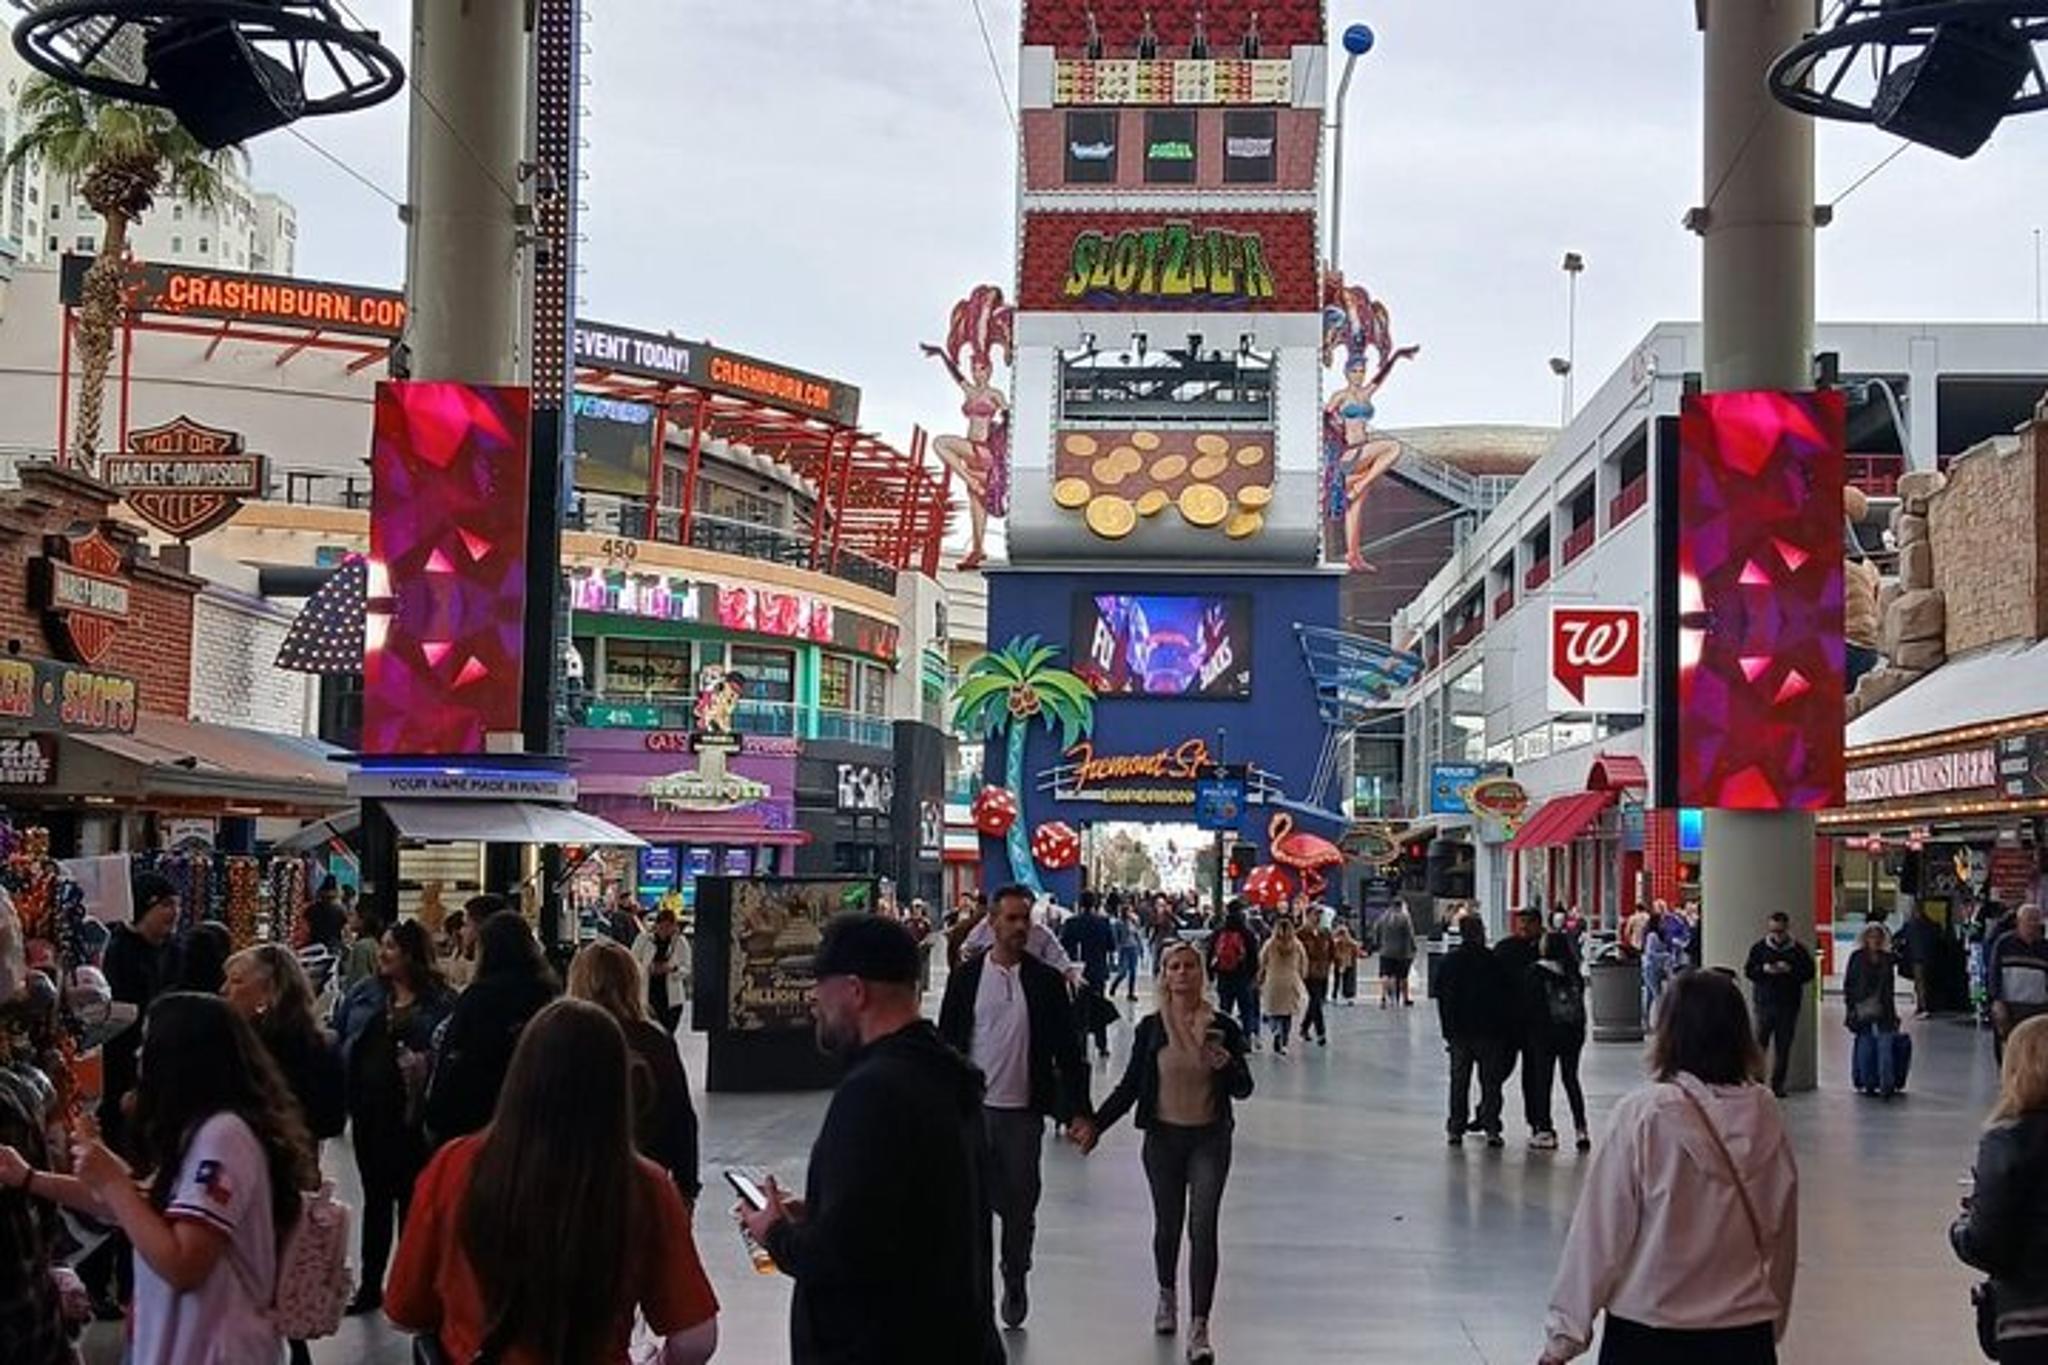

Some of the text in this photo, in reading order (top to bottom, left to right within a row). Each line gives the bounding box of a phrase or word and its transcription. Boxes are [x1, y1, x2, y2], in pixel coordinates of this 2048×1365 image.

[1065, 221, 1273, 297] SLOTZILLA
[574, 329, 629, 363] EVENT
[110, 460, 250, 487] HARLEY-DAVIDSON
[602, 540, 637, 561] 450
[1066, 742, 1170, 796] Fremont
